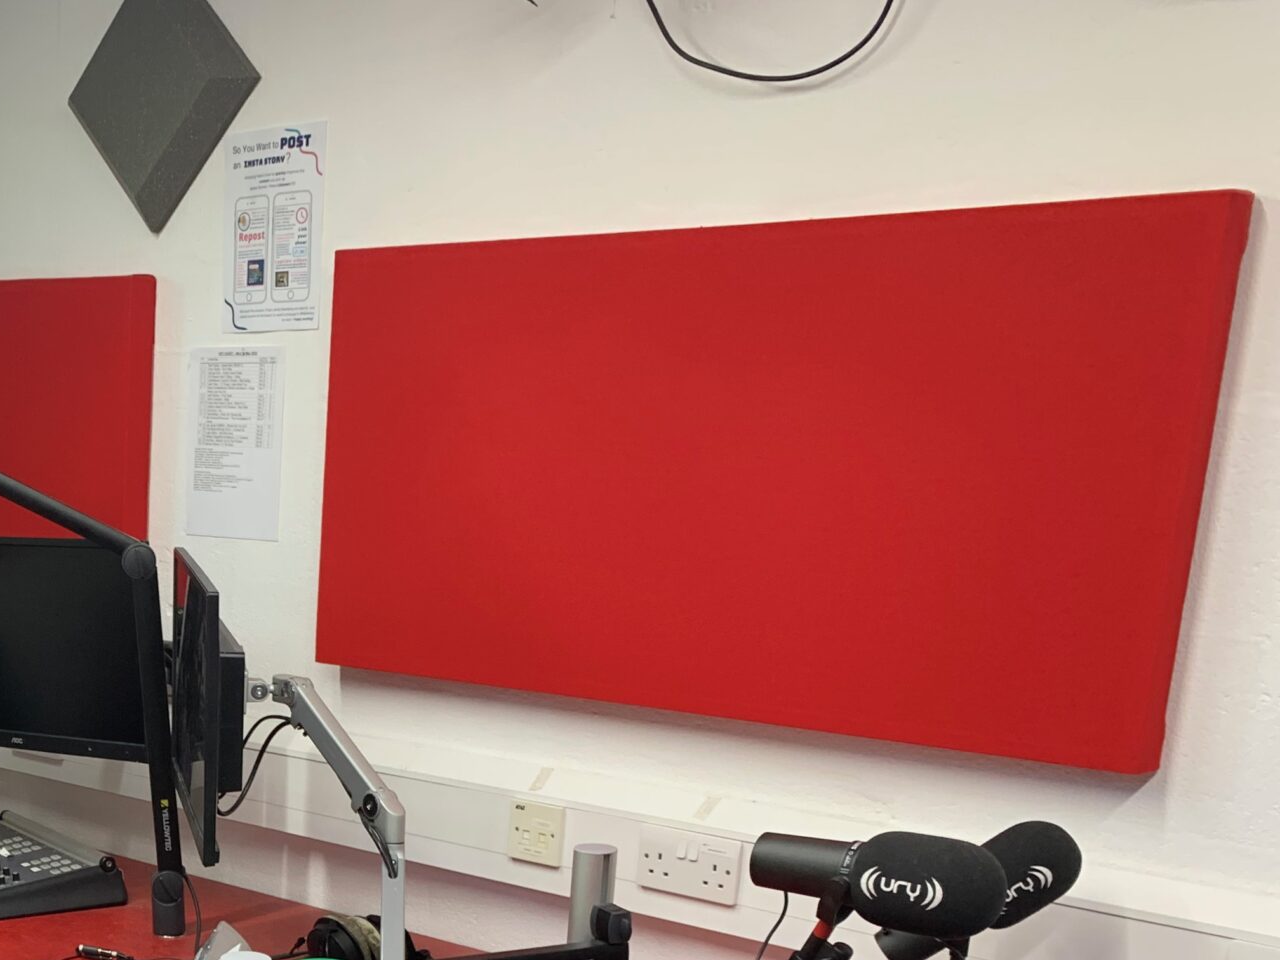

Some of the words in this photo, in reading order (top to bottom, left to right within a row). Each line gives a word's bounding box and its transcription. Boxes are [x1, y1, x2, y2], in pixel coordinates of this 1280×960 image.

[232, 145, 241, 155] So
[243, 145, 255, 153] You
[256, 142, 271, 151] Want
[272, 140, 279, 149] to
[280, 134, 311, 150] POST
[233, 162, 241, 170] an
[244, 159, 263, 168] INSTA
[238, 231, 265, 243] Repost
[162, 808, 172, 852] YELLOWTEC
[880, 875, 922, 902] ury
